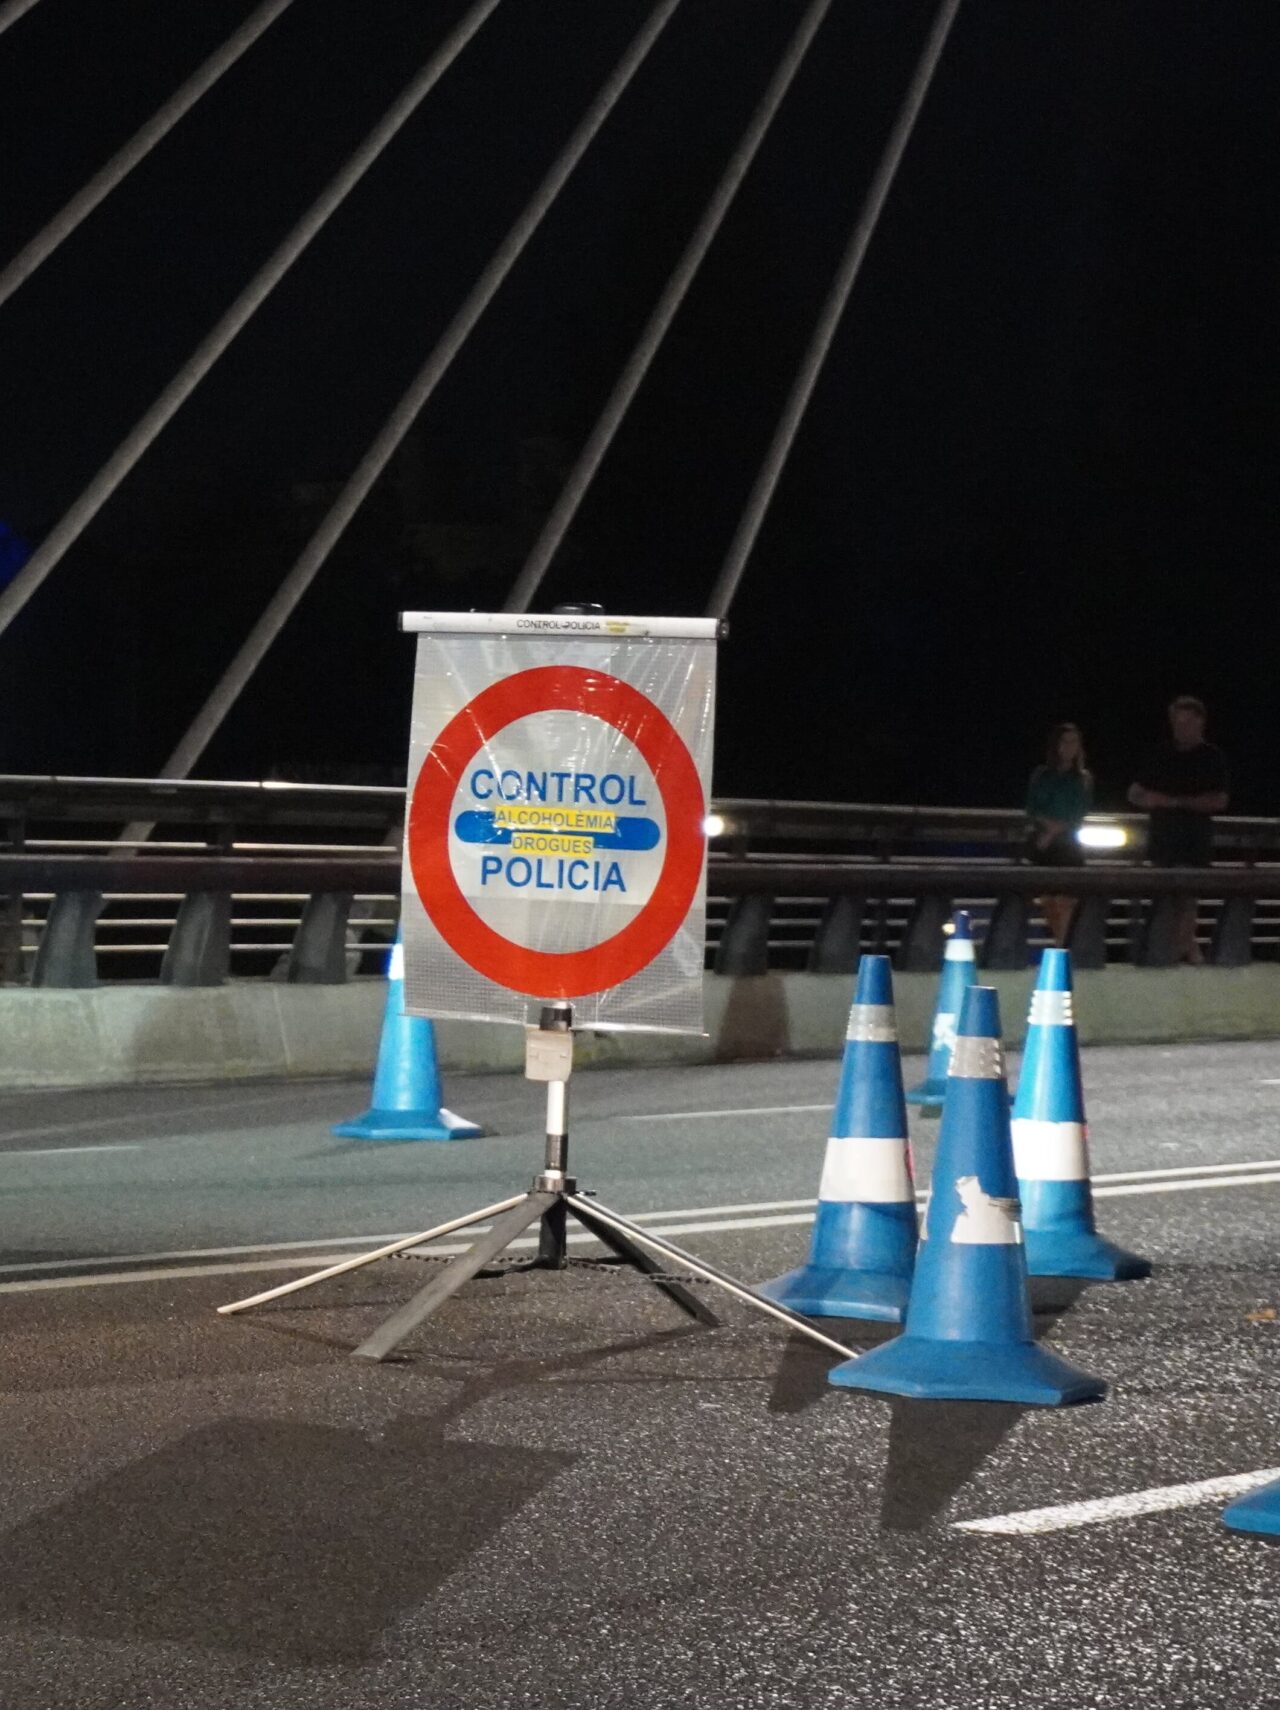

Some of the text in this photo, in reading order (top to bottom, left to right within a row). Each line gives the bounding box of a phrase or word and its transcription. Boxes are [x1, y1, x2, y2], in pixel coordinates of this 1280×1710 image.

[470, 769, 646, 806] CONTROL
[512, 836, 592, 854] DROGUES
[481, 856, 626, 892] POLICIA
